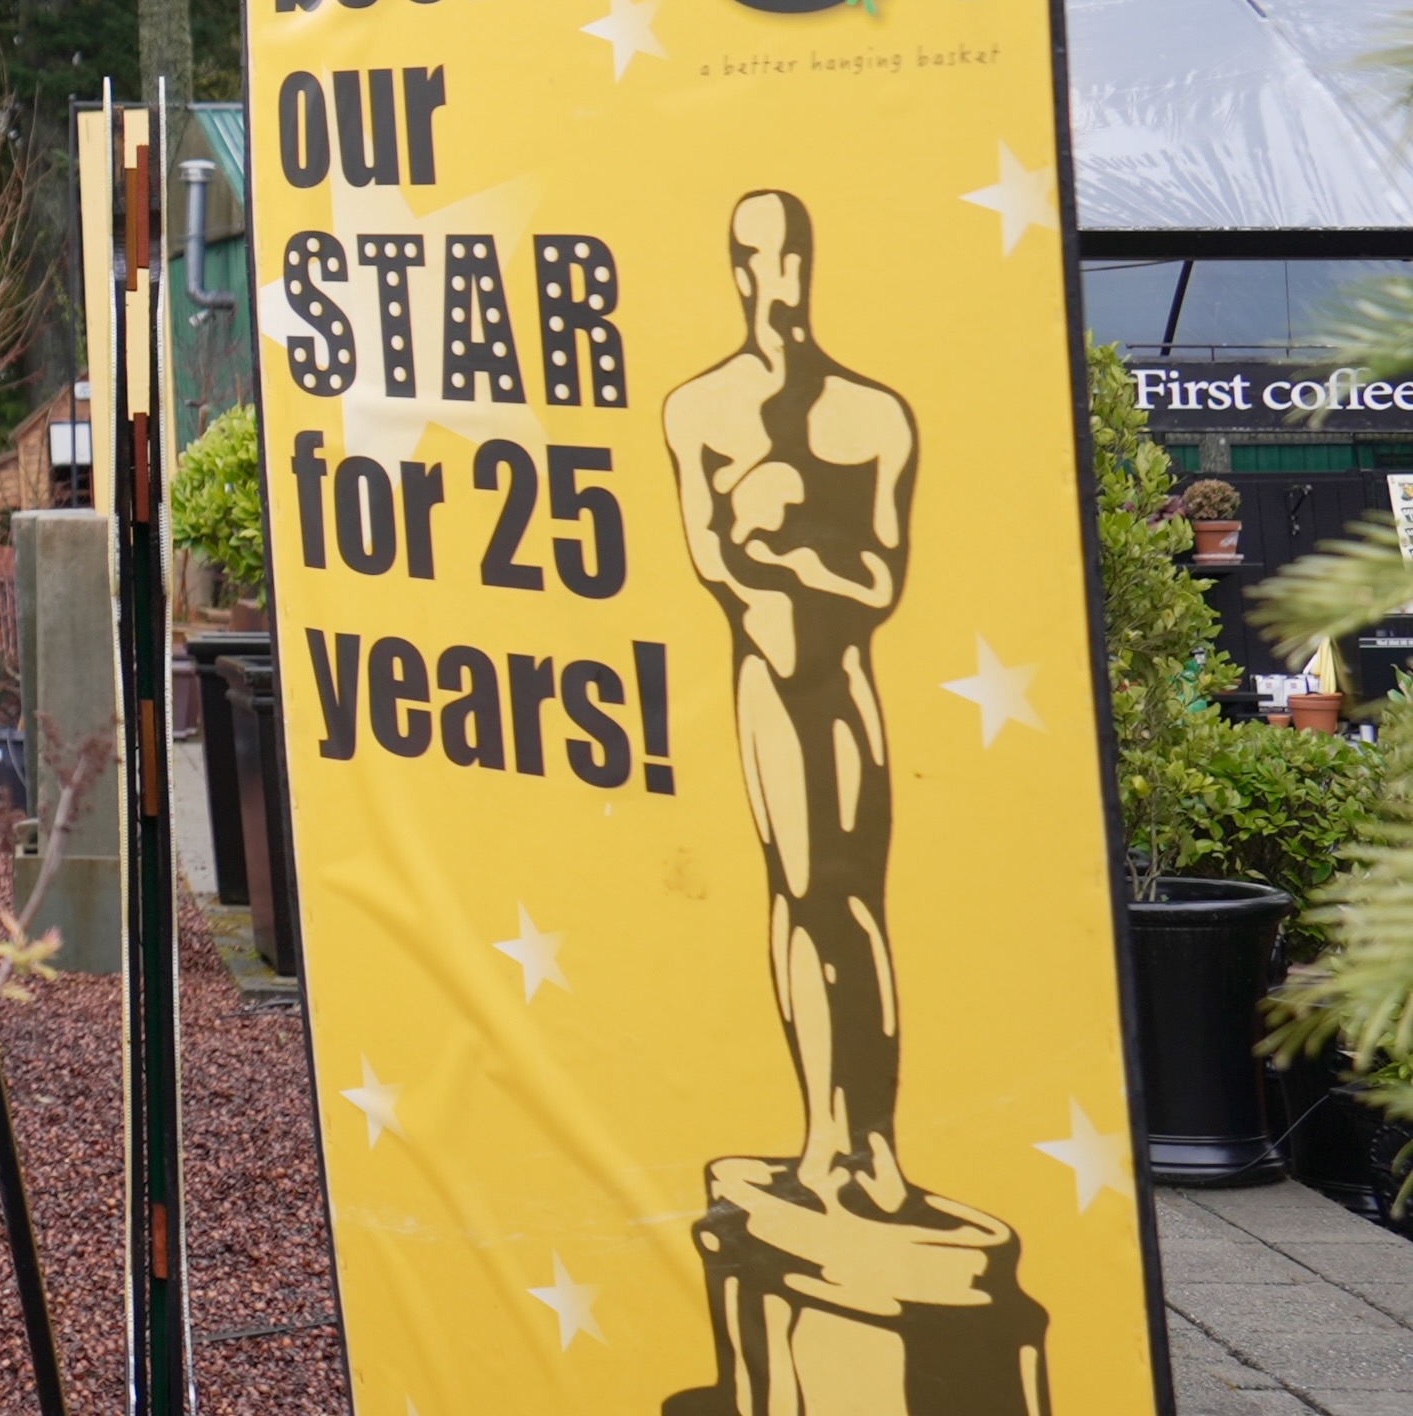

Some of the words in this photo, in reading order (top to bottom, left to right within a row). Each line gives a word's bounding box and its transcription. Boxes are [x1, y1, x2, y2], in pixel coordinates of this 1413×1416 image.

[278, 61, 446, 188] our
[700, 64, 710, 76] a
[723, 54, 798, 75] better
[811, 46, 903, 75] hanging
[917, 43, 1001, 68] basket
[283, 230, 628, 408] STAR
[1130, 369, 1252, 410] First
[290, 430, 445, 580] for
[473, 439, 627, 600] 25
[305, 628, 676, 797] years!
